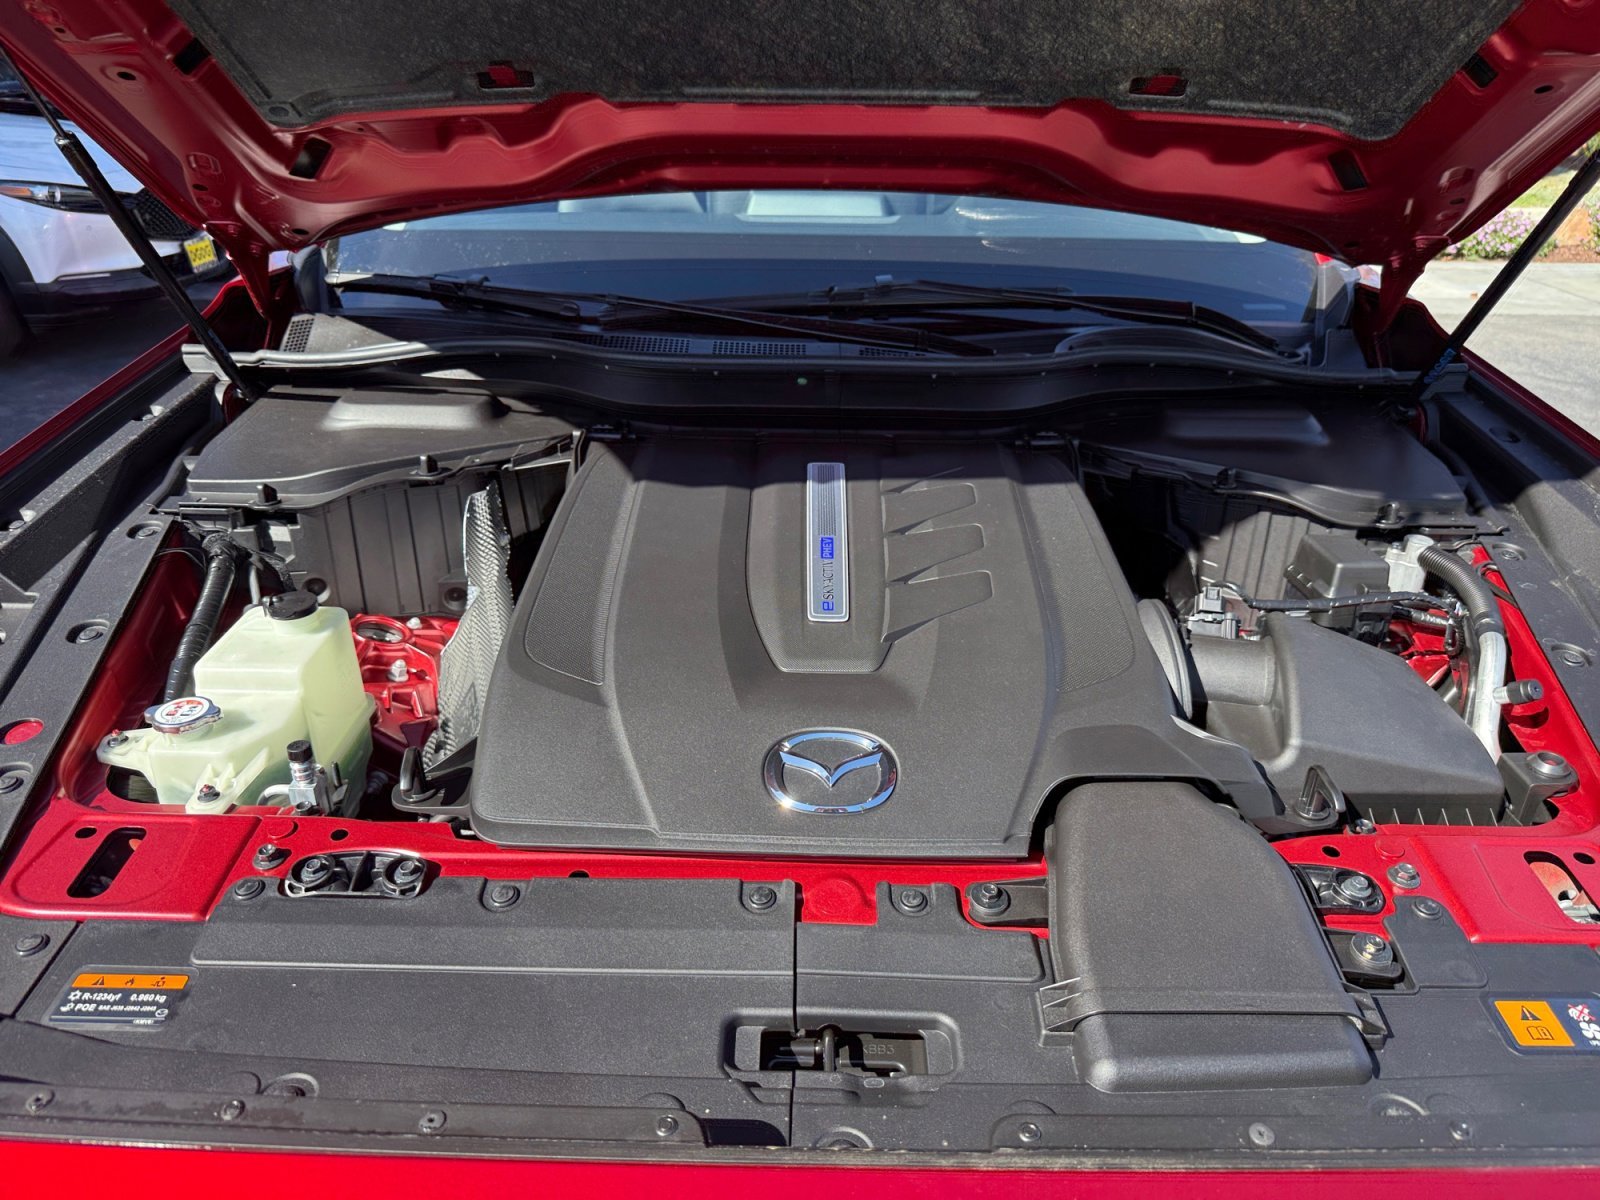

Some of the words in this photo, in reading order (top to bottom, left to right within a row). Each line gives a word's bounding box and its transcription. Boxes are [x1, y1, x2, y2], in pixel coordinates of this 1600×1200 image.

[822, 537, 833, 559] PHEV
[81, 992, 121, 1002] R-1234yf
[155, 994, 167, 1003] kg
[75, 1003, 96, 1012] POE
